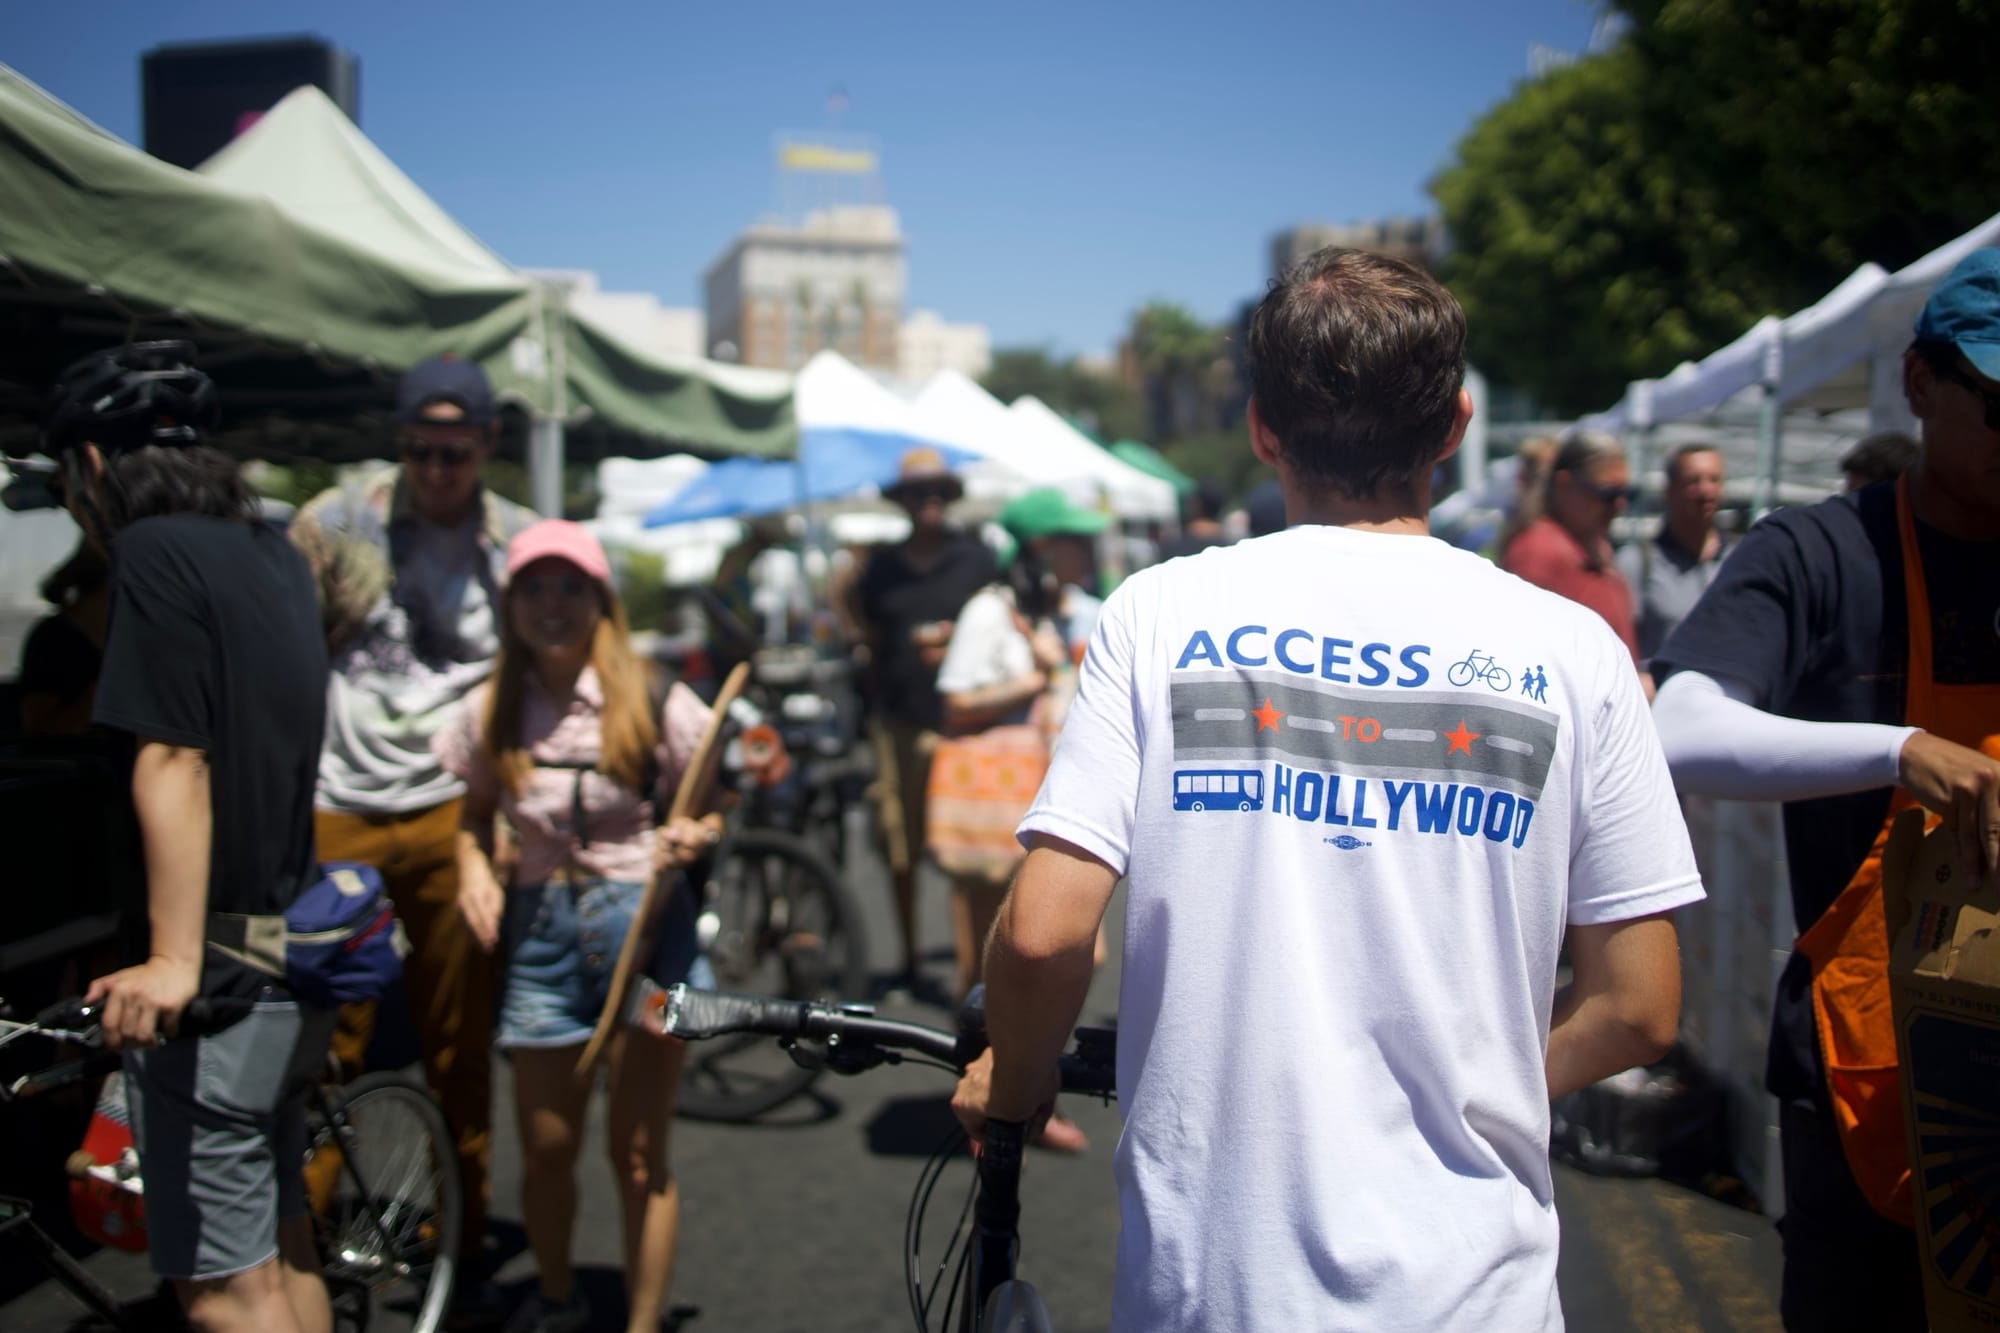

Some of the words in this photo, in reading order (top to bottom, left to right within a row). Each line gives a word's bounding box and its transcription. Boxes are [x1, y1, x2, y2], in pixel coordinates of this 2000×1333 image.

[1175, 625, 1431, 688] ACCESS
[1337, 715, 1381, 743] TO
[1272, 763, 1535, 849] HOLLYWOOD
